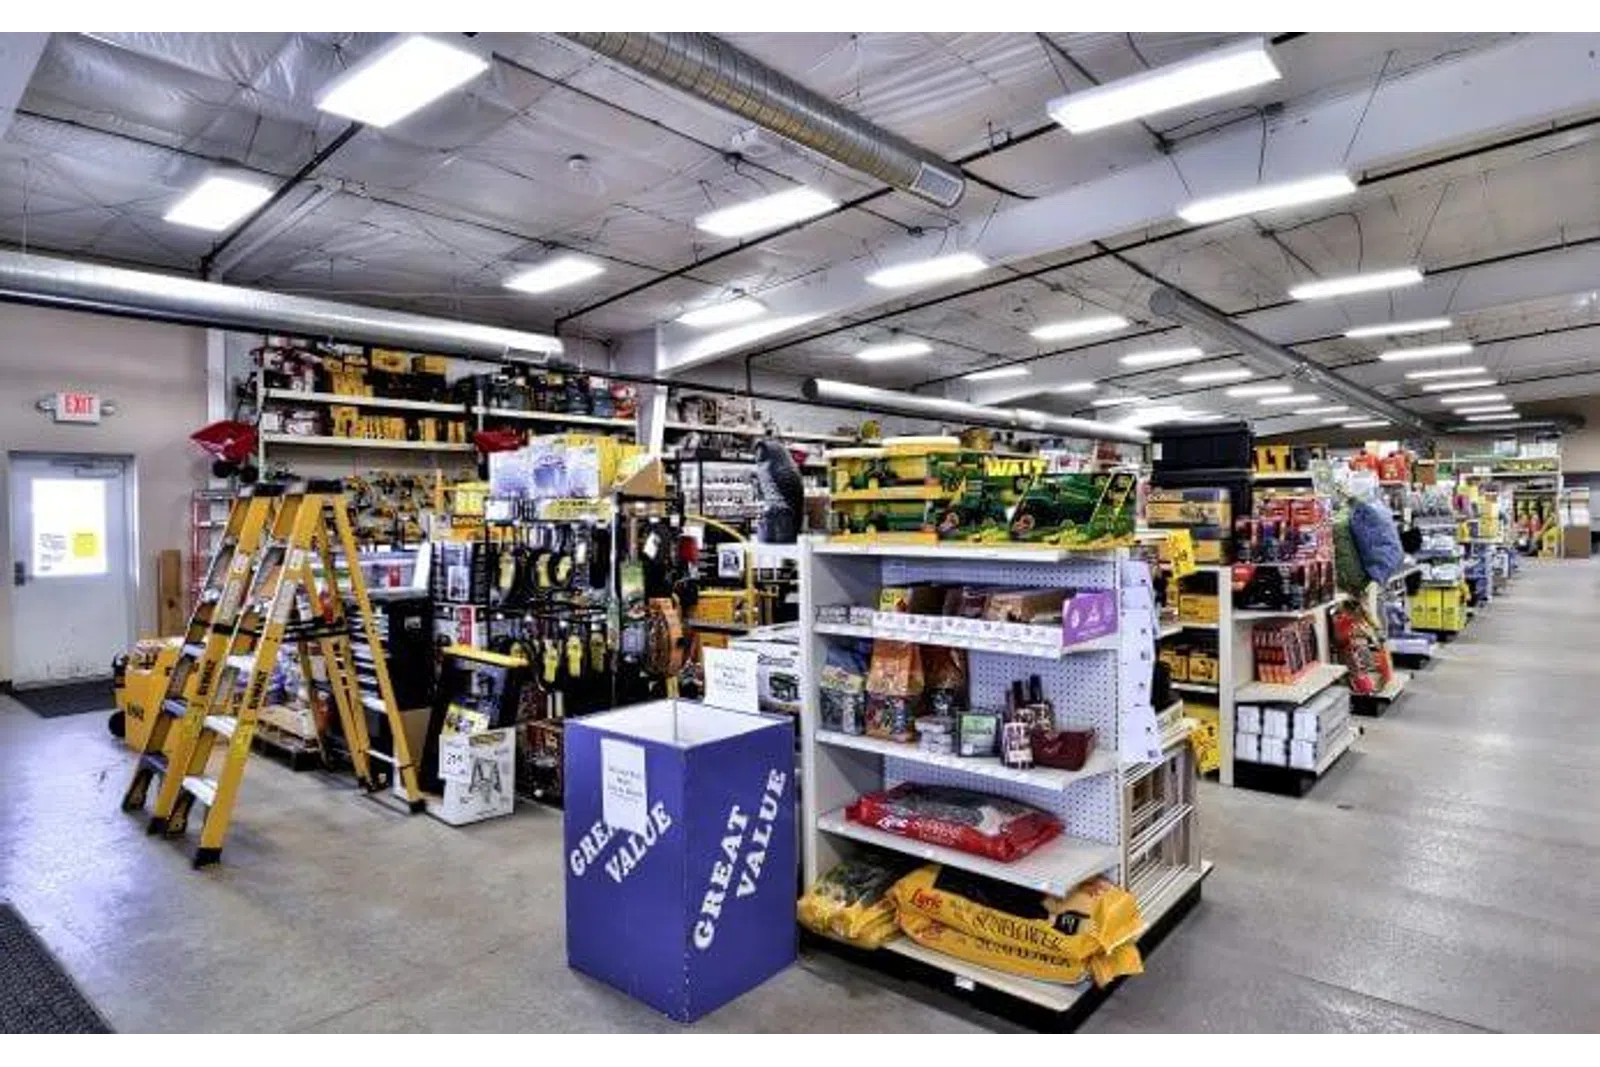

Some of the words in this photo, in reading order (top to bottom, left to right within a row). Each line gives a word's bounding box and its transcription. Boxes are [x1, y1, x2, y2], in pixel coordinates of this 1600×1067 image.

[65, 394, 93, 414] EXIT
[570, 820, 613, 876] GRE
[605, 802, 672, 883] VALUE
[736, 768, 786, 897] VALUE
[693, 805, 748, 950] GREAT
